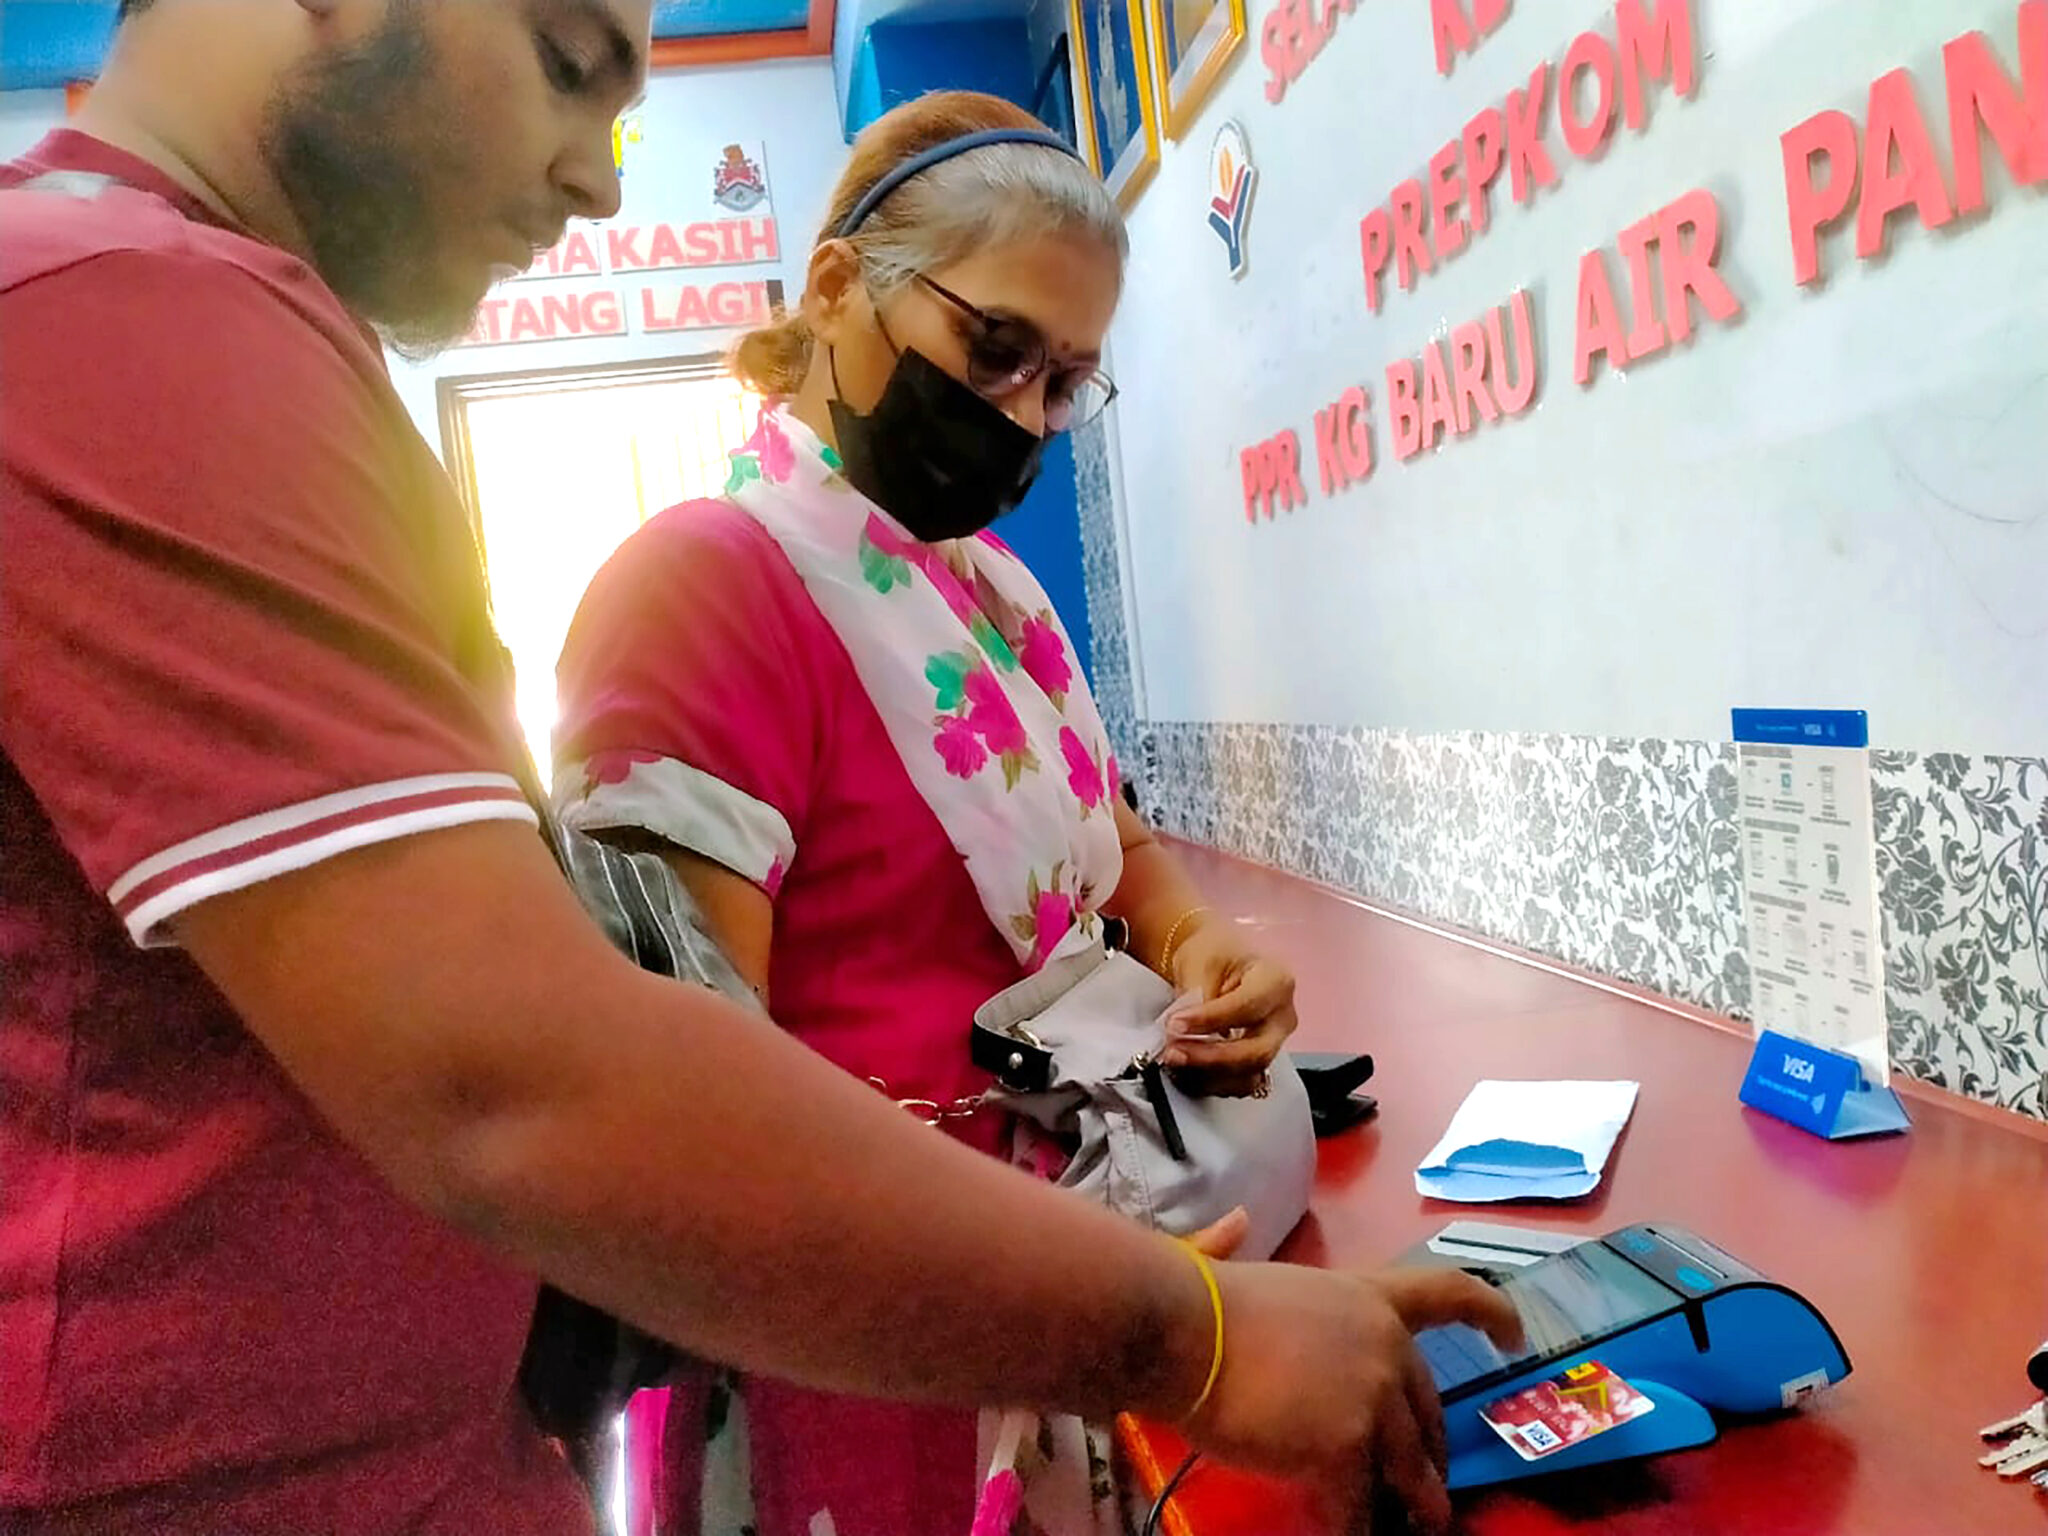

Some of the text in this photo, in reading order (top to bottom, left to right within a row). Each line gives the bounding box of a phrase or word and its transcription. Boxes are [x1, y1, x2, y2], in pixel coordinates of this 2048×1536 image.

[1360, 0, 1694, 311] PREPKOM
[607, 217, 777, 268] KASIH
[1240, 0, 2048, 523] PPR KG BARU AIR PAN
[474, 281, 767, 341] TANG LAGI
[1783, 1053, 1815, 1083] VISA
